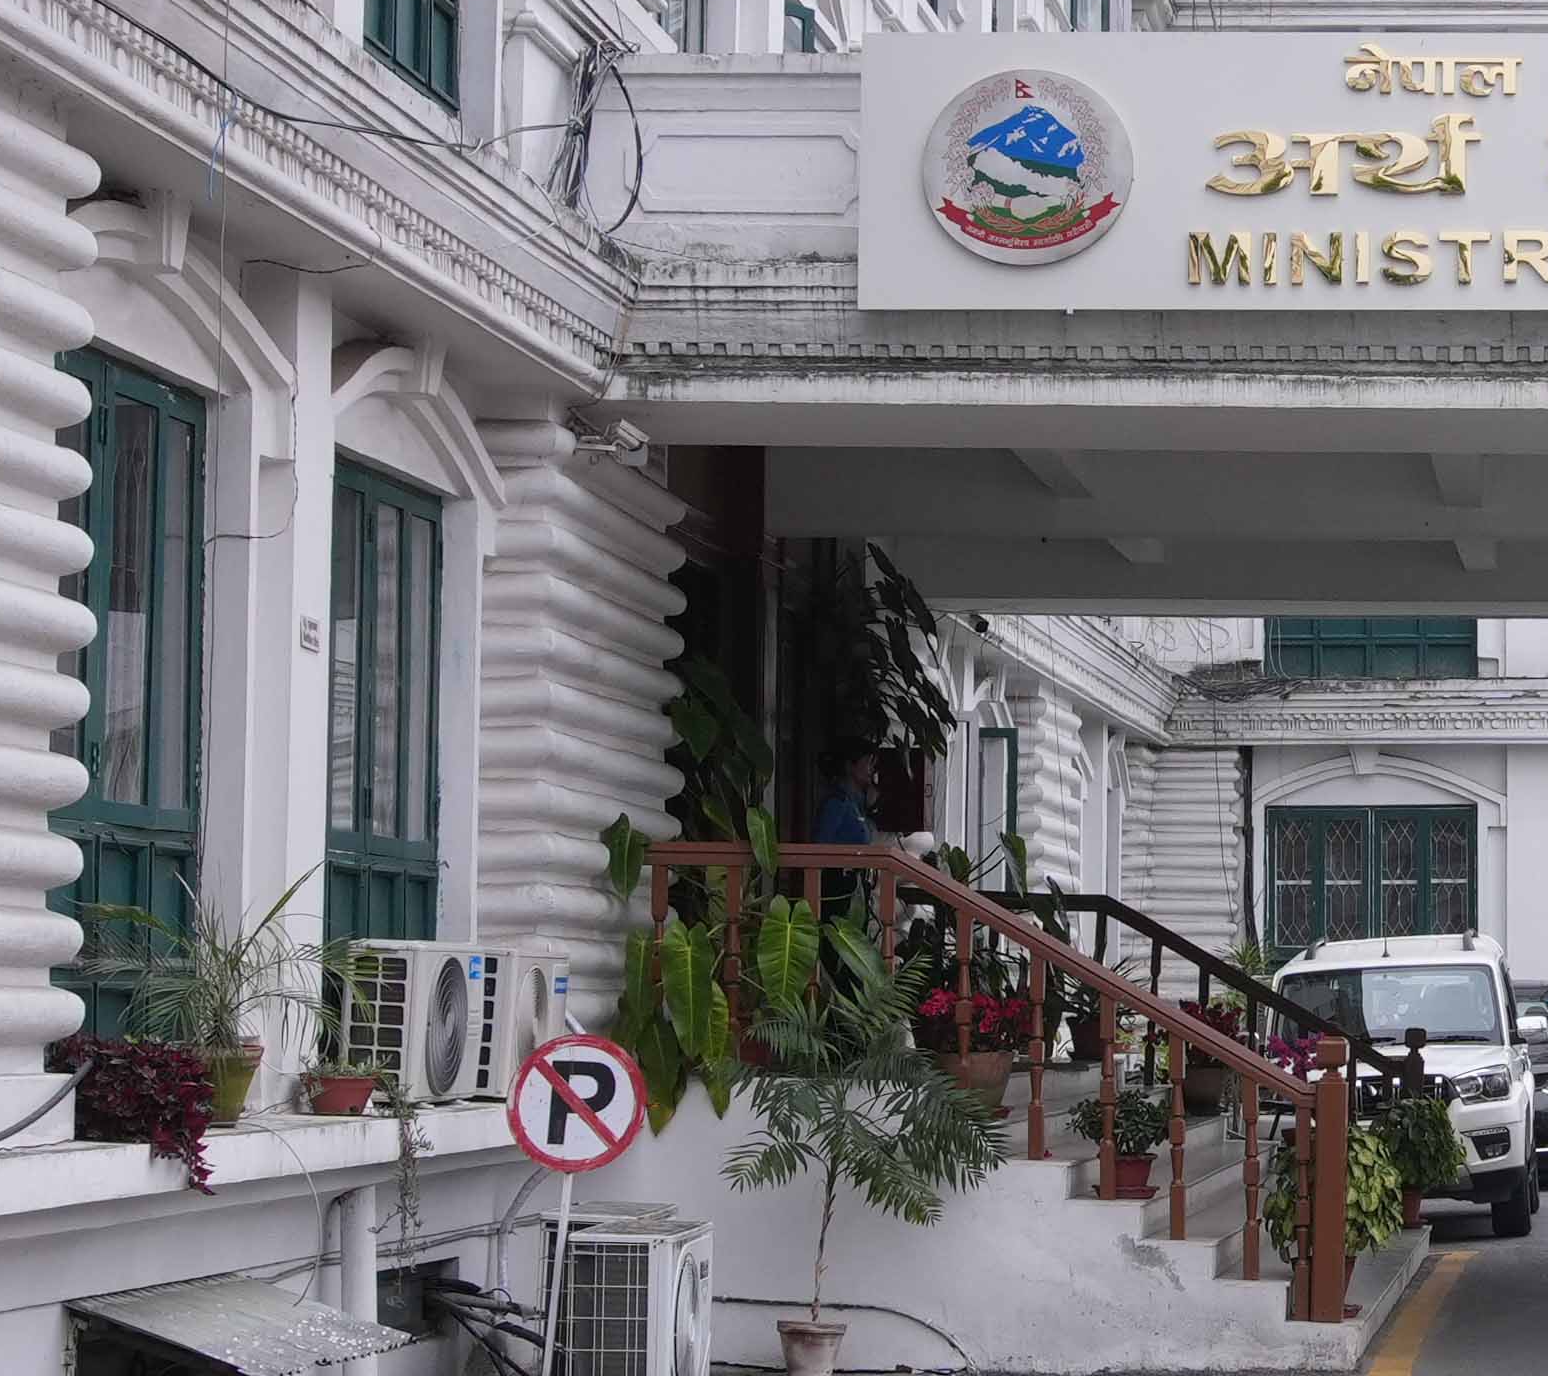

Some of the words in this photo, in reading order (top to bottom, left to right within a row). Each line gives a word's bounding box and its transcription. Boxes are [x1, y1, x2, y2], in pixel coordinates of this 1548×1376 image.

[1344, 41, 1524, 97] नेपाल
[1205, 112, 1485, 197] अर्थ
[547, 1060, 616, 1145] P
